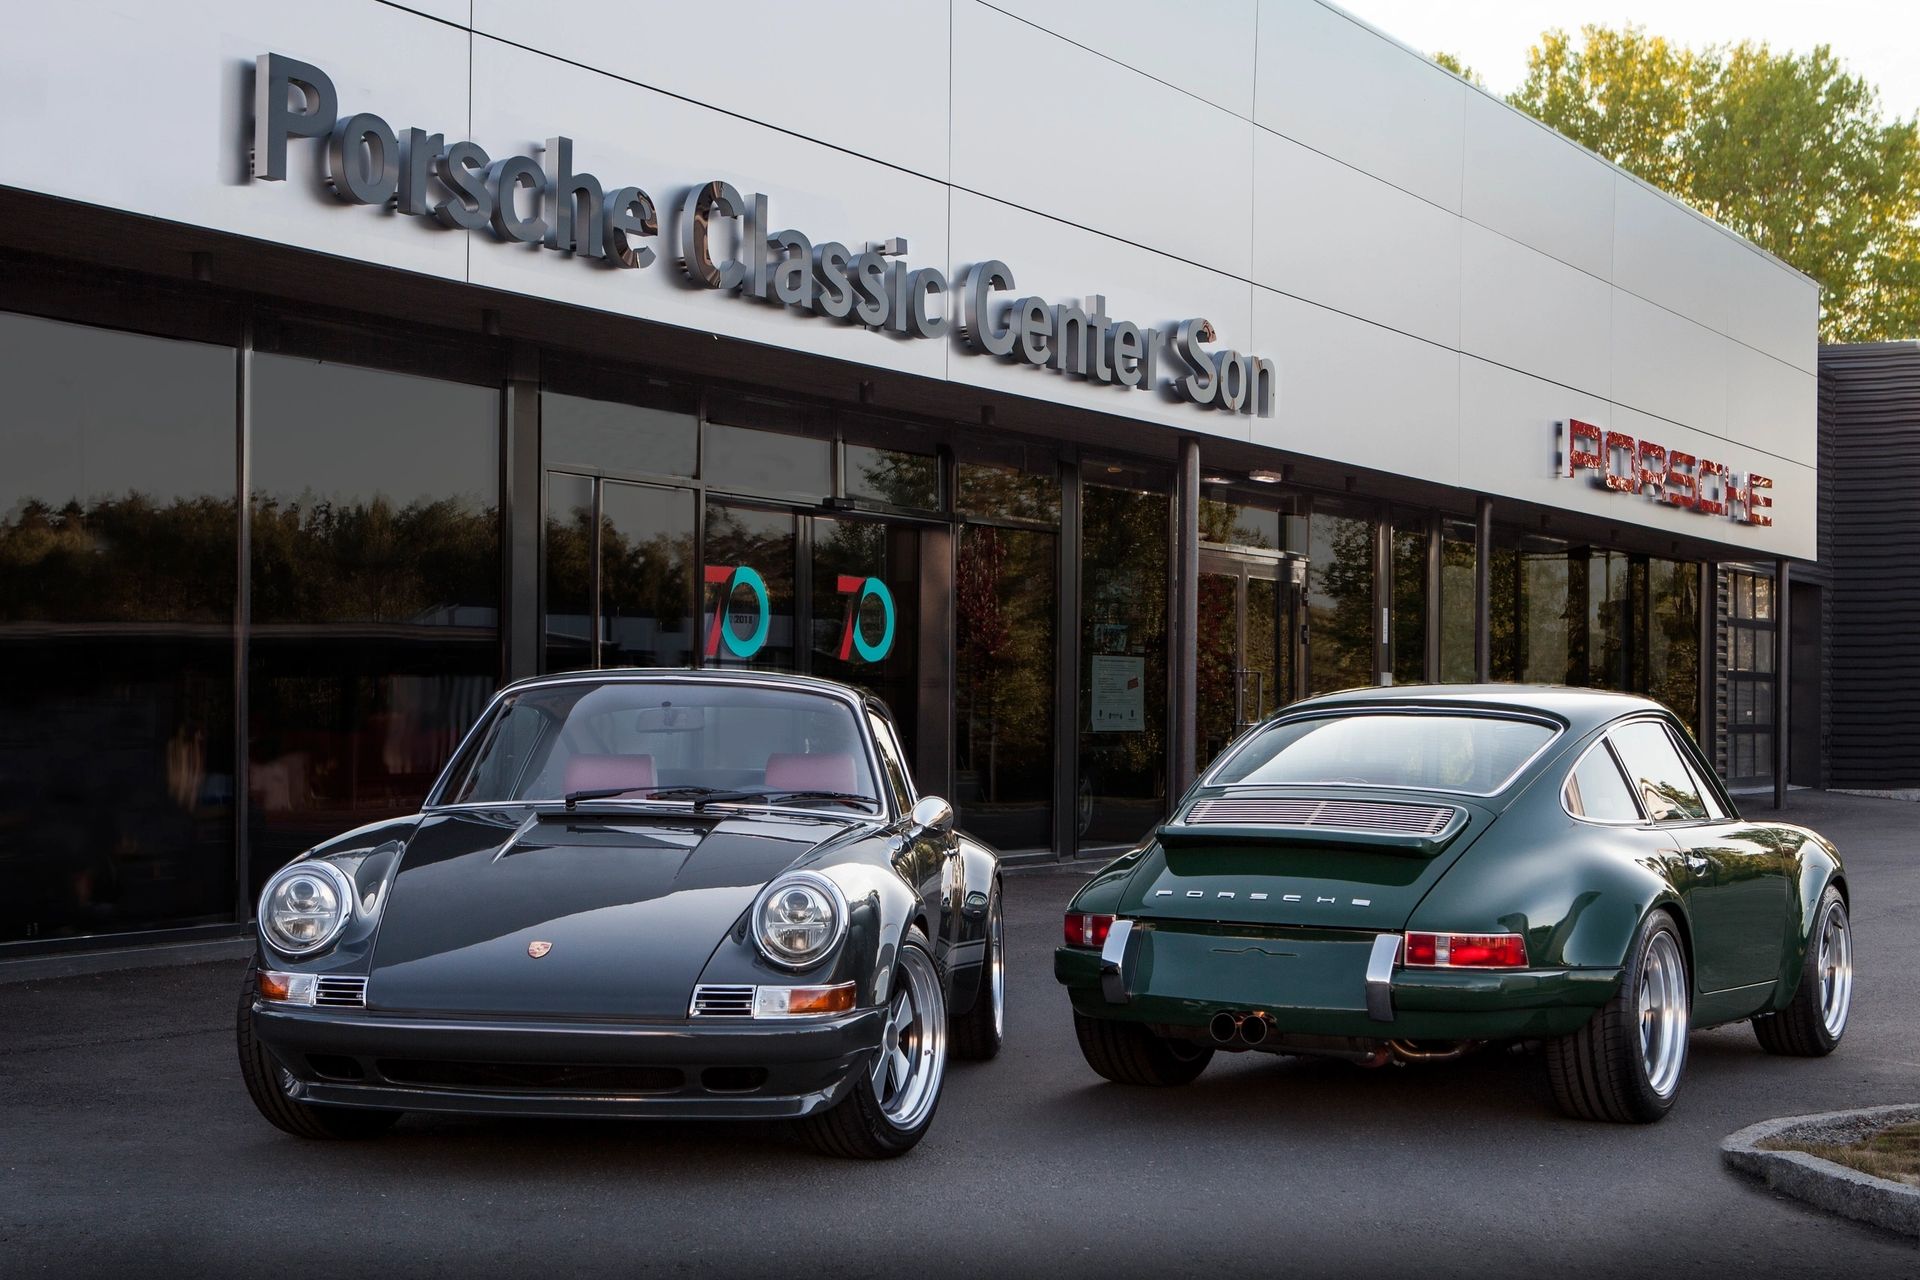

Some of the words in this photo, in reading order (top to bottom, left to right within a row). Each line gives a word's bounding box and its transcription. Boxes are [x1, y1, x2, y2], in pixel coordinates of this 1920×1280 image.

[254, 52, 658, 269] Porsche
[682, 180, 948, 339] Classic
[965, 259, 1163, 391] Center
[1175, 317, 1276, 418] Son
[1561, 418, 1773, 527] PORSCHE
[704, 565, 769, 658] 70
[837, 575, 895, 663] 70
[1155, 889, 1371, 907] PORSCHE
